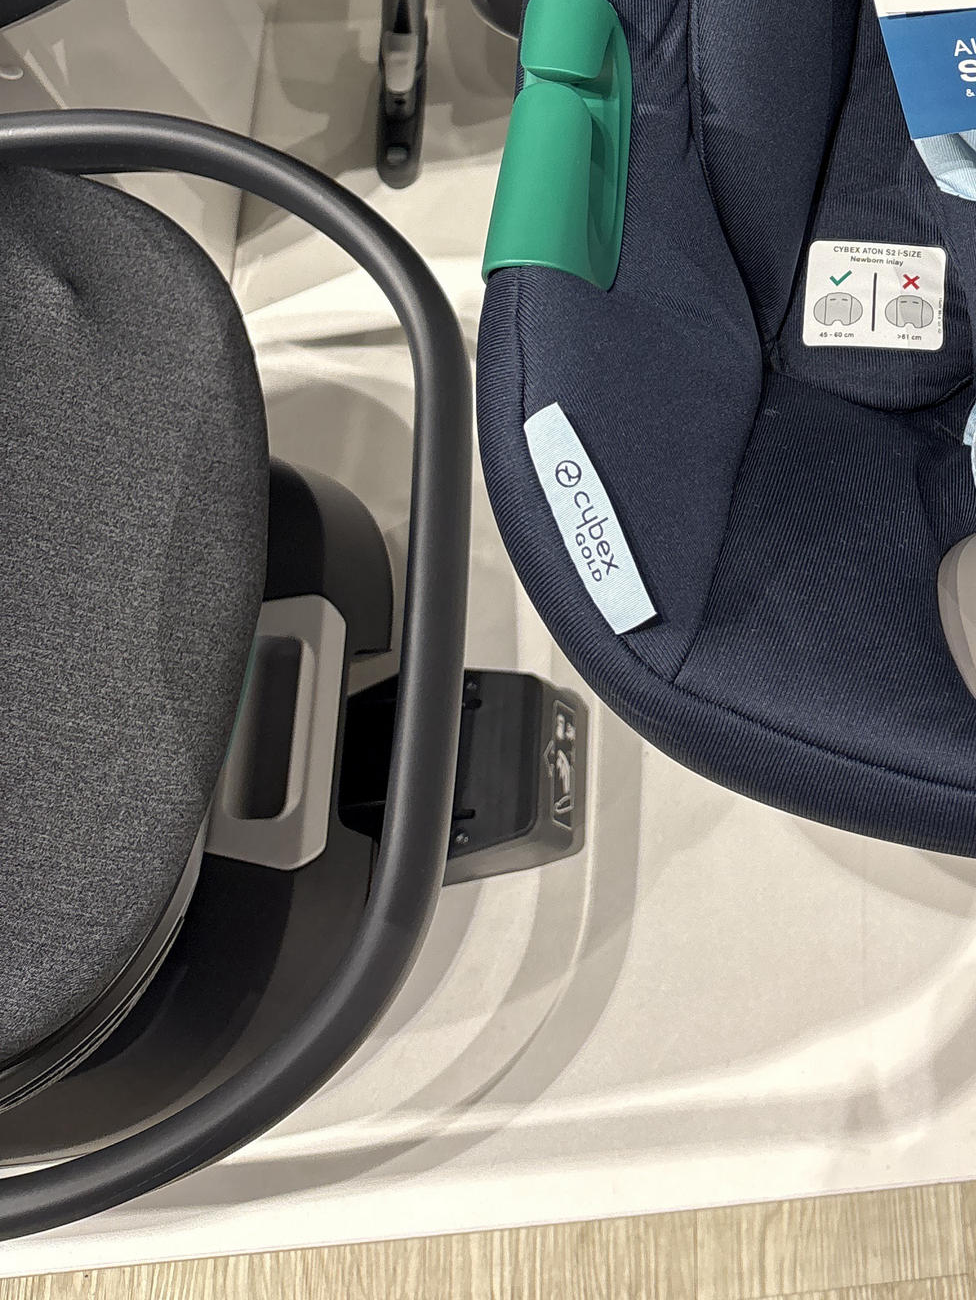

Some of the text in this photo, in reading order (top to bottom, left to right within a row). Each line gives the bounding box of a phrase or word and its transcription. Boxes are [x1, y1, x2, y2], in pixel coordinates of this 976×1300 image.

[965, 88, 975, 97] &
[833, 246, 860, 254] CYBEX
[862, 247, 884, 255] ATON
[885, 248, 896, 256] S2
[850, 256, 904, 267] Newborn inlay
[573, 490, 619, 576] cybex
[575, 532, 603, 582] GOLD
